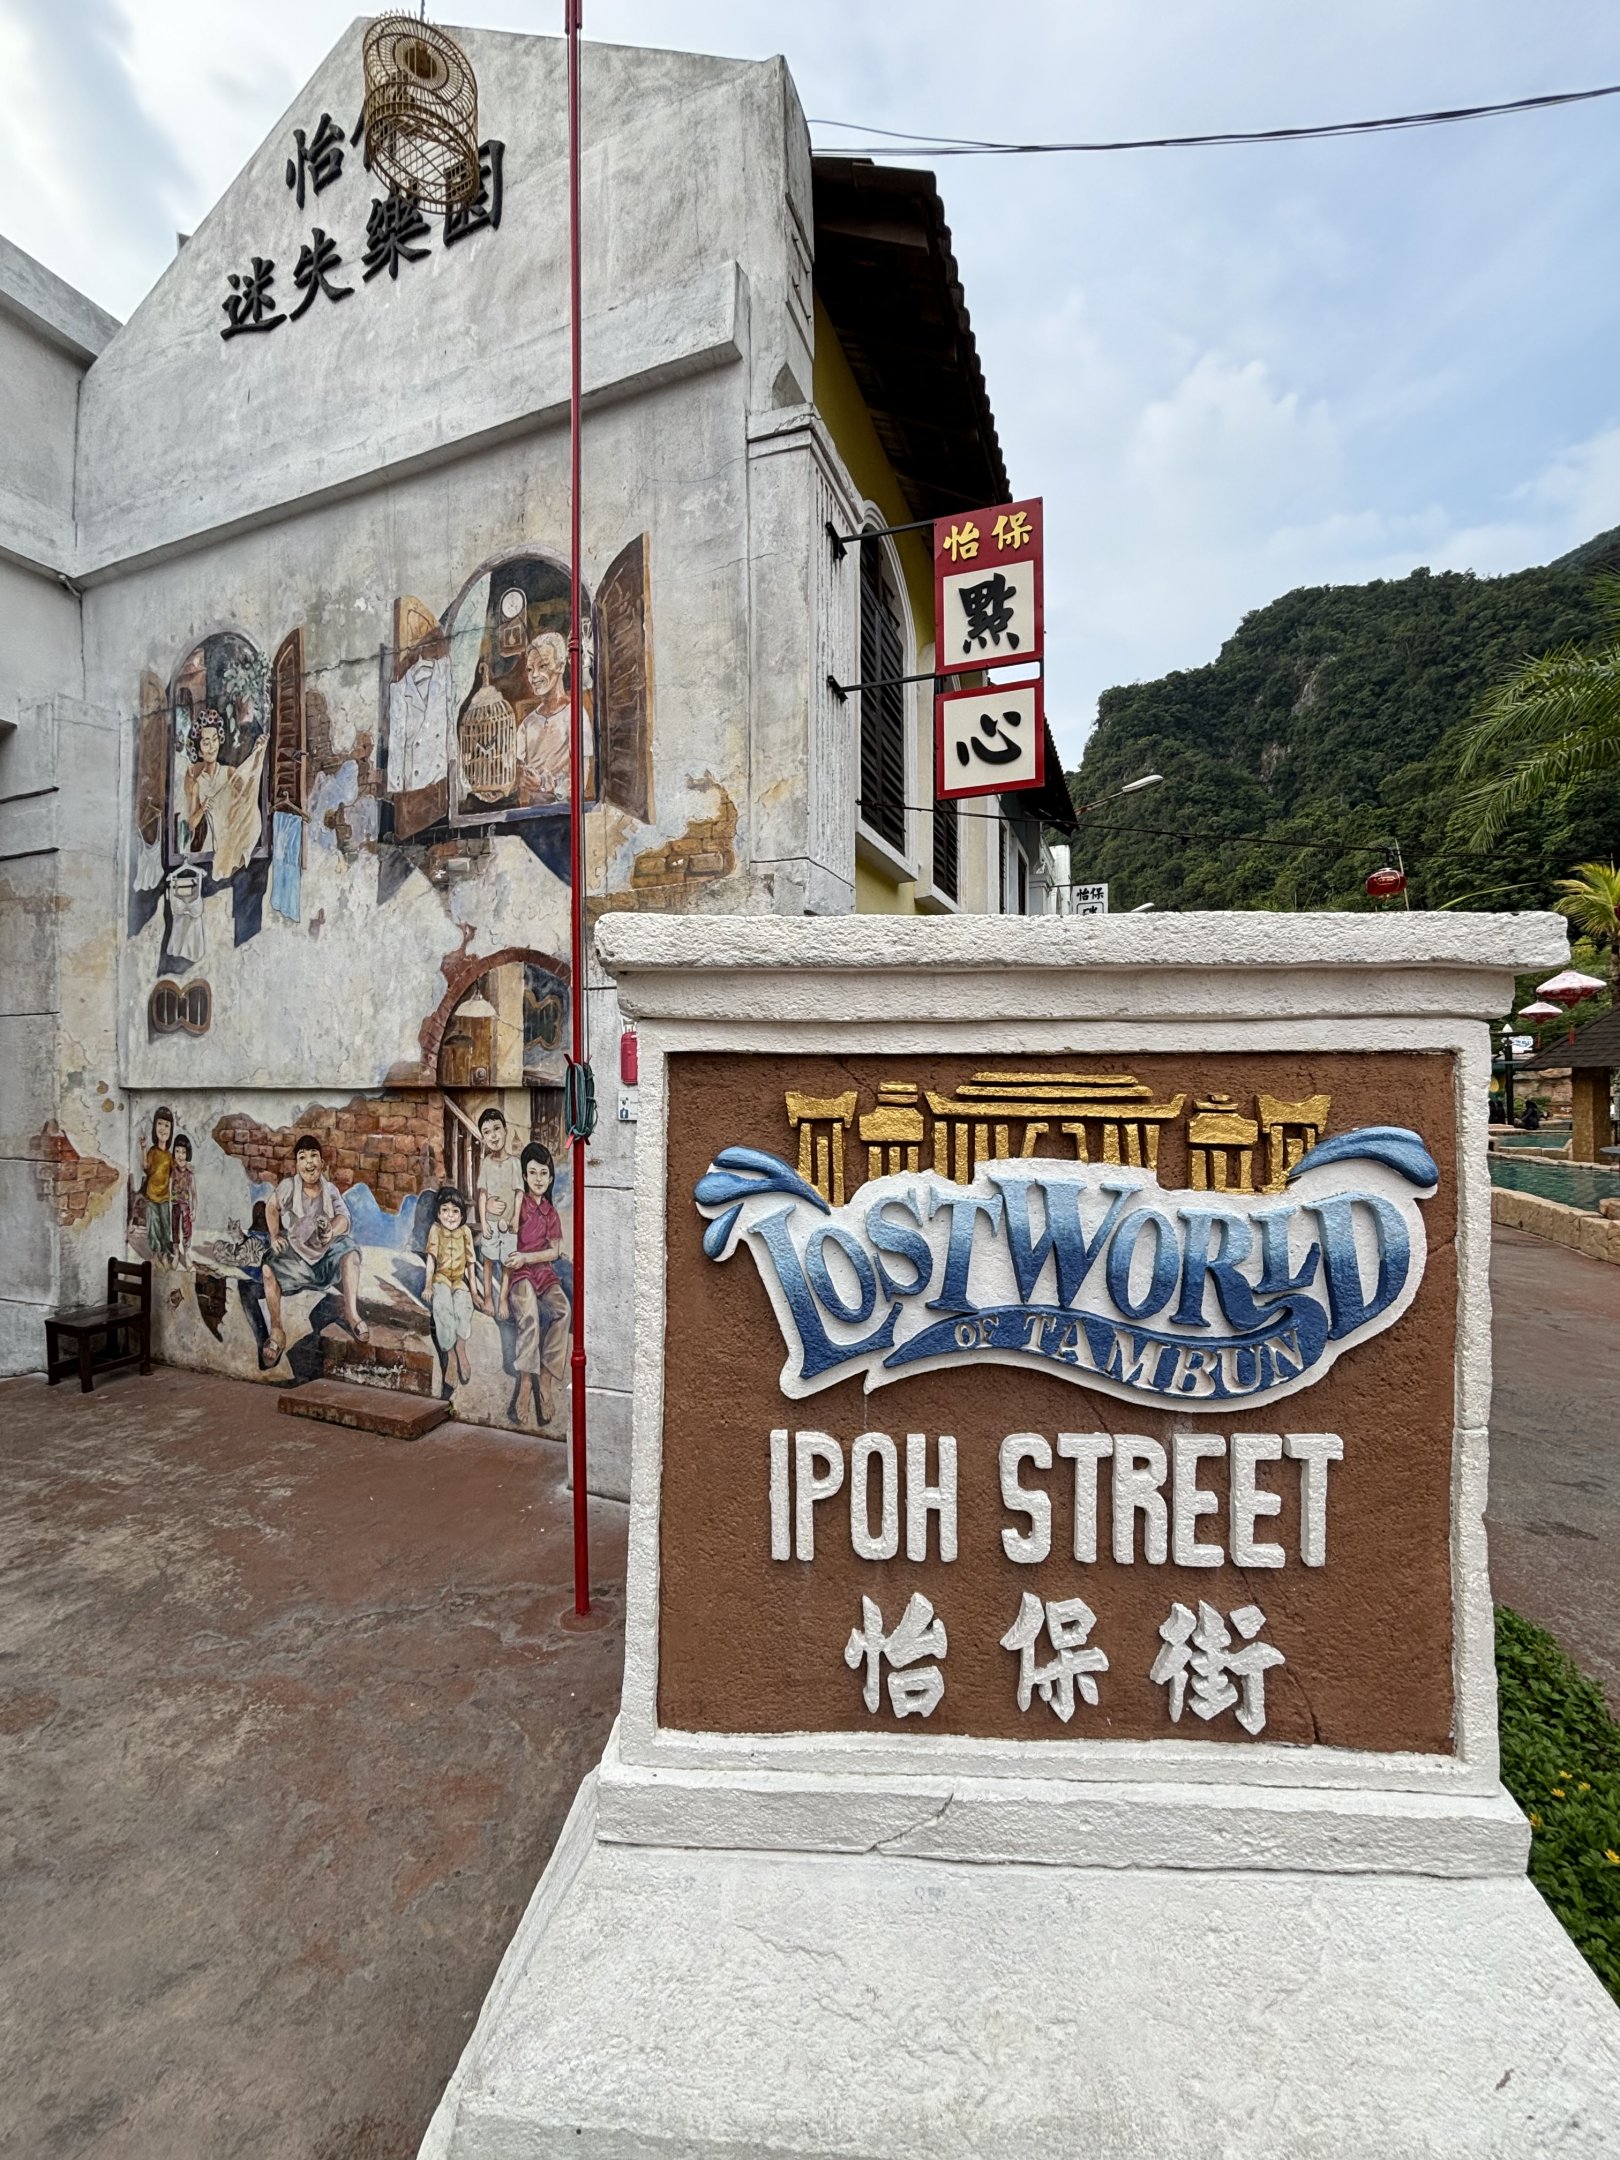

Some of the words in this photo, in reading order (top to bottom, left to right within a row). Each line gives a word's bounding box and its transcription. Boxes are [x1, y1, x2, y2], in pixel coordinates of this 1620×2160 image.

[942, 510, 1033, 562] 怡保
[956, 572, 1022, 767] 點心
[1076, 887, 1104, 901] 怡保
[748, 1185, 1003, 1380] LOST
[987, 1175, 1411, 1341] WORLD
[954, 1316, 1000, 1348] OF
[1023, 1312, 1304, 1396] TAMBUN
[769, 1429, 958, 1563] IPOH
[1000, 1432, 1345, 1569] STREET
[844, 1591, 1286, 1736] 怡保街
